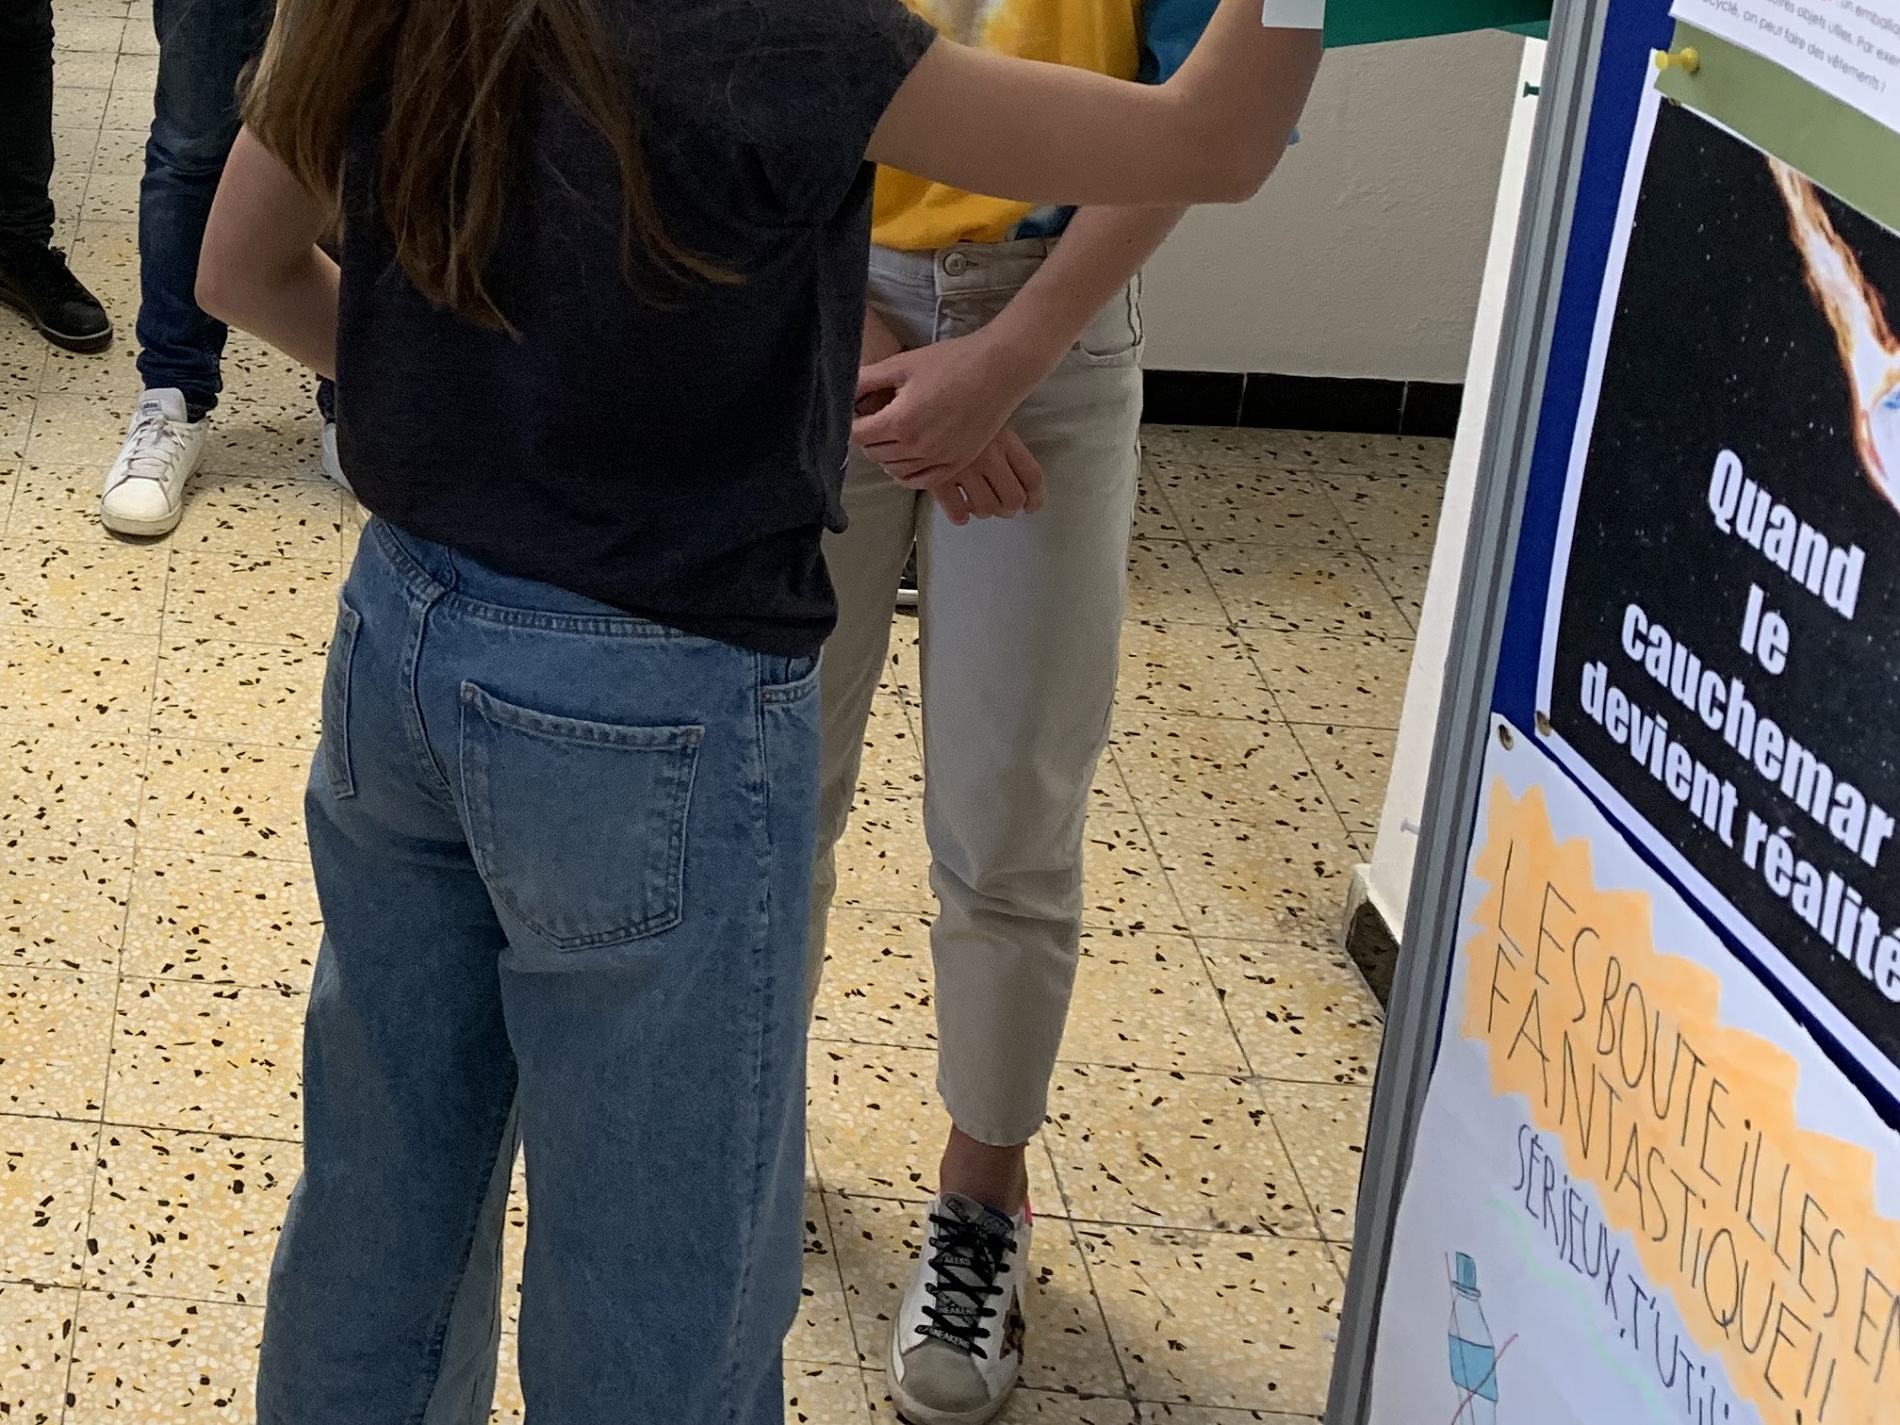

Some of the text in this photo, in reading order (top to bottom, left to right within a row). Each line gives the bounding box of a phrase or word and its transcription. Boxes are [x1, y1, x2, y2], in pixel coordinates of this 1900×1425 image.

[1743, 10, 1758, 25] on
[1758, 16, 1784, 37] peut
[1784, 28, 1806, 51] faire
[1807, 42, 1825, 62] des
[1827, 54, 1880, 92] vêtements
[1797, 6, 1827, 31] objets
[1856, 35, 1874, 54] Par
[1707, 448, 1866, 621] Quand
[1740, 582, 1790, 675] le
[1621, 603, 1895, 868] cauchemar
[1580, 660, 1900, 1003] devient réalité
[1498, 839, 1600, 1023] LES
